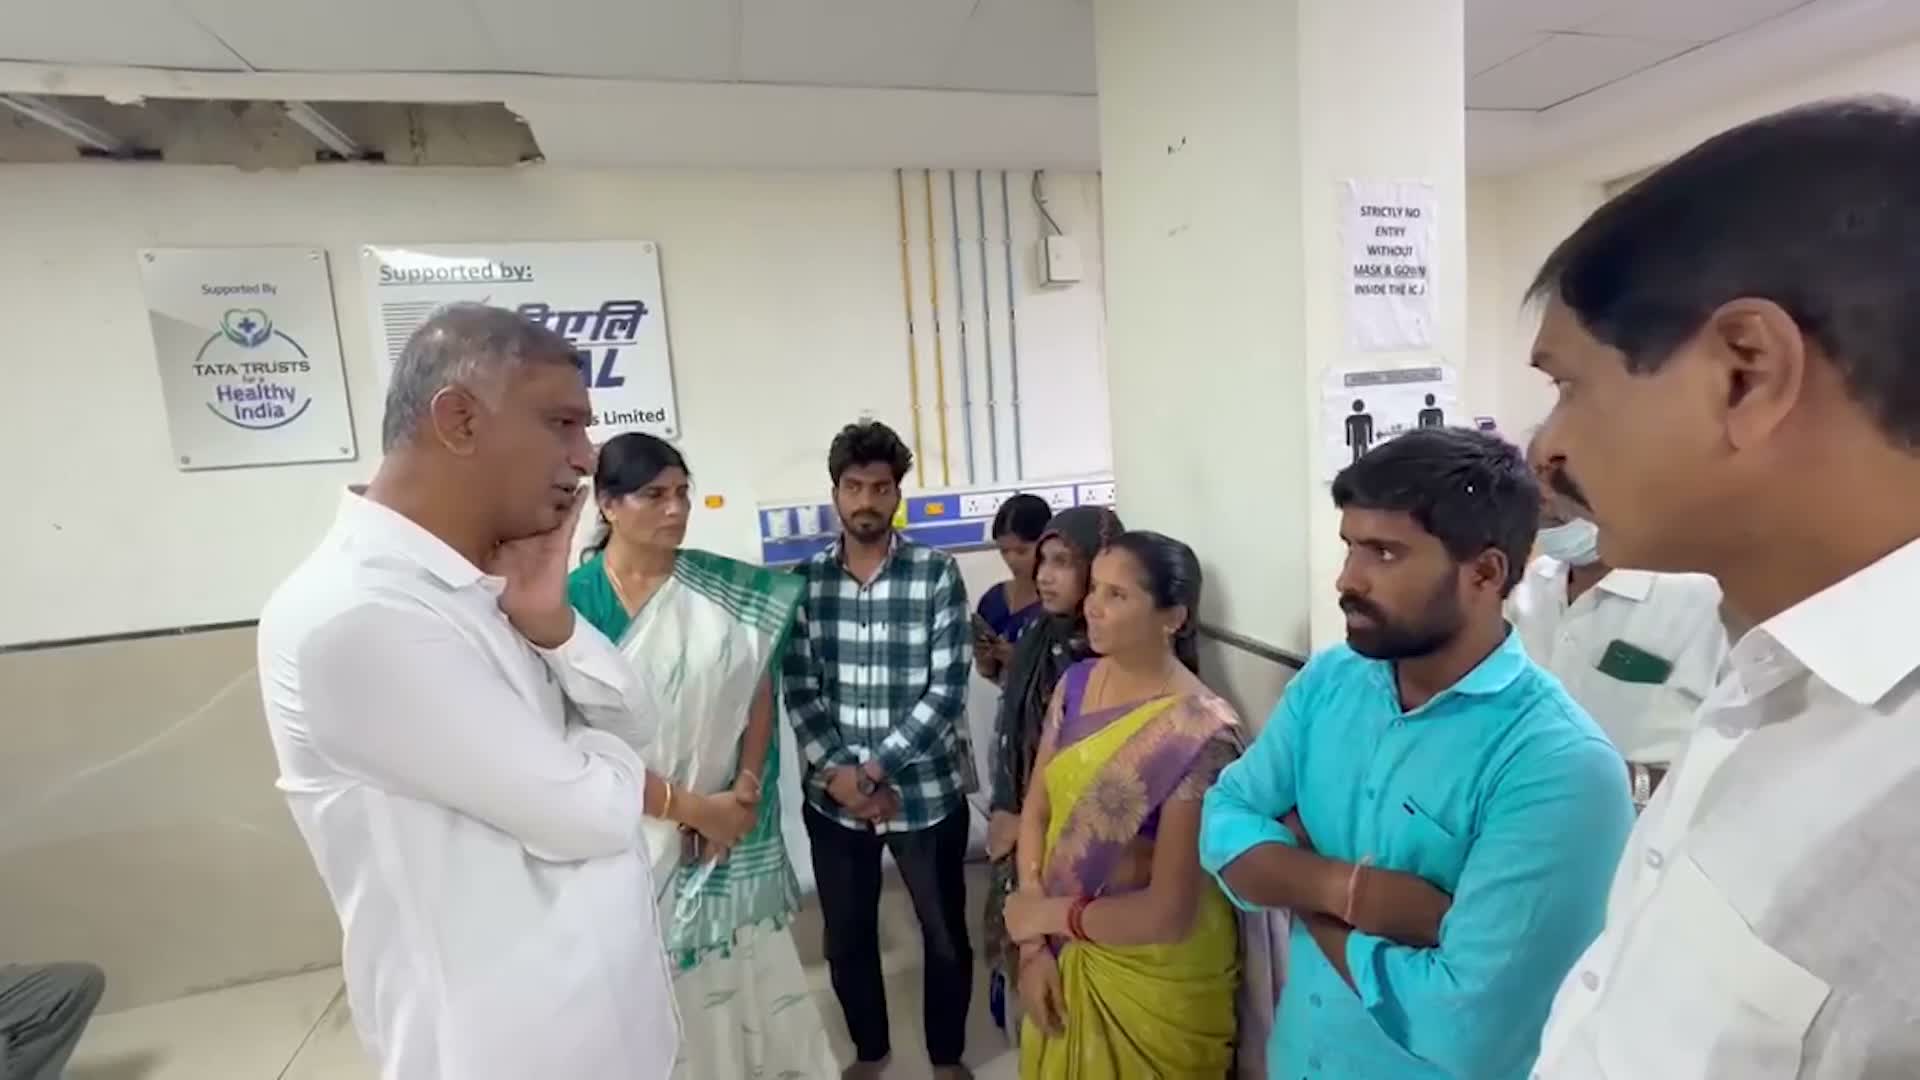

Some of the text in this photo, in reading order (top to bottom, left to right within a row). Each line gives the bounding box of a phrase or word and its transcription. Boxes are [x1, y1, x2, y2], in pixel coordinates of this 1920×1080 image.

[1360, 205, 1421, 218] STRICTLY NO
[1375, 226, 1406, 237] ENTRY
[1367, 245, 1413, 257] WITHOUT
[379, 261, 534, 284] Supported by:
[1354, 264, 1382, 277] MASK
[1394, 265, 1426, 278] GOWN
[201, 283, 277, 296] Supported By
[1355, 284, 1387, 296] INSIDE
[1389, 285, 1406, 296] THE
[192, 360, 311, 376] TATA TRUSTS
[216, 383, 296, 403] Healthy
[235, 402, 286, 420] India
[604, 408, 665, 425] Limited
